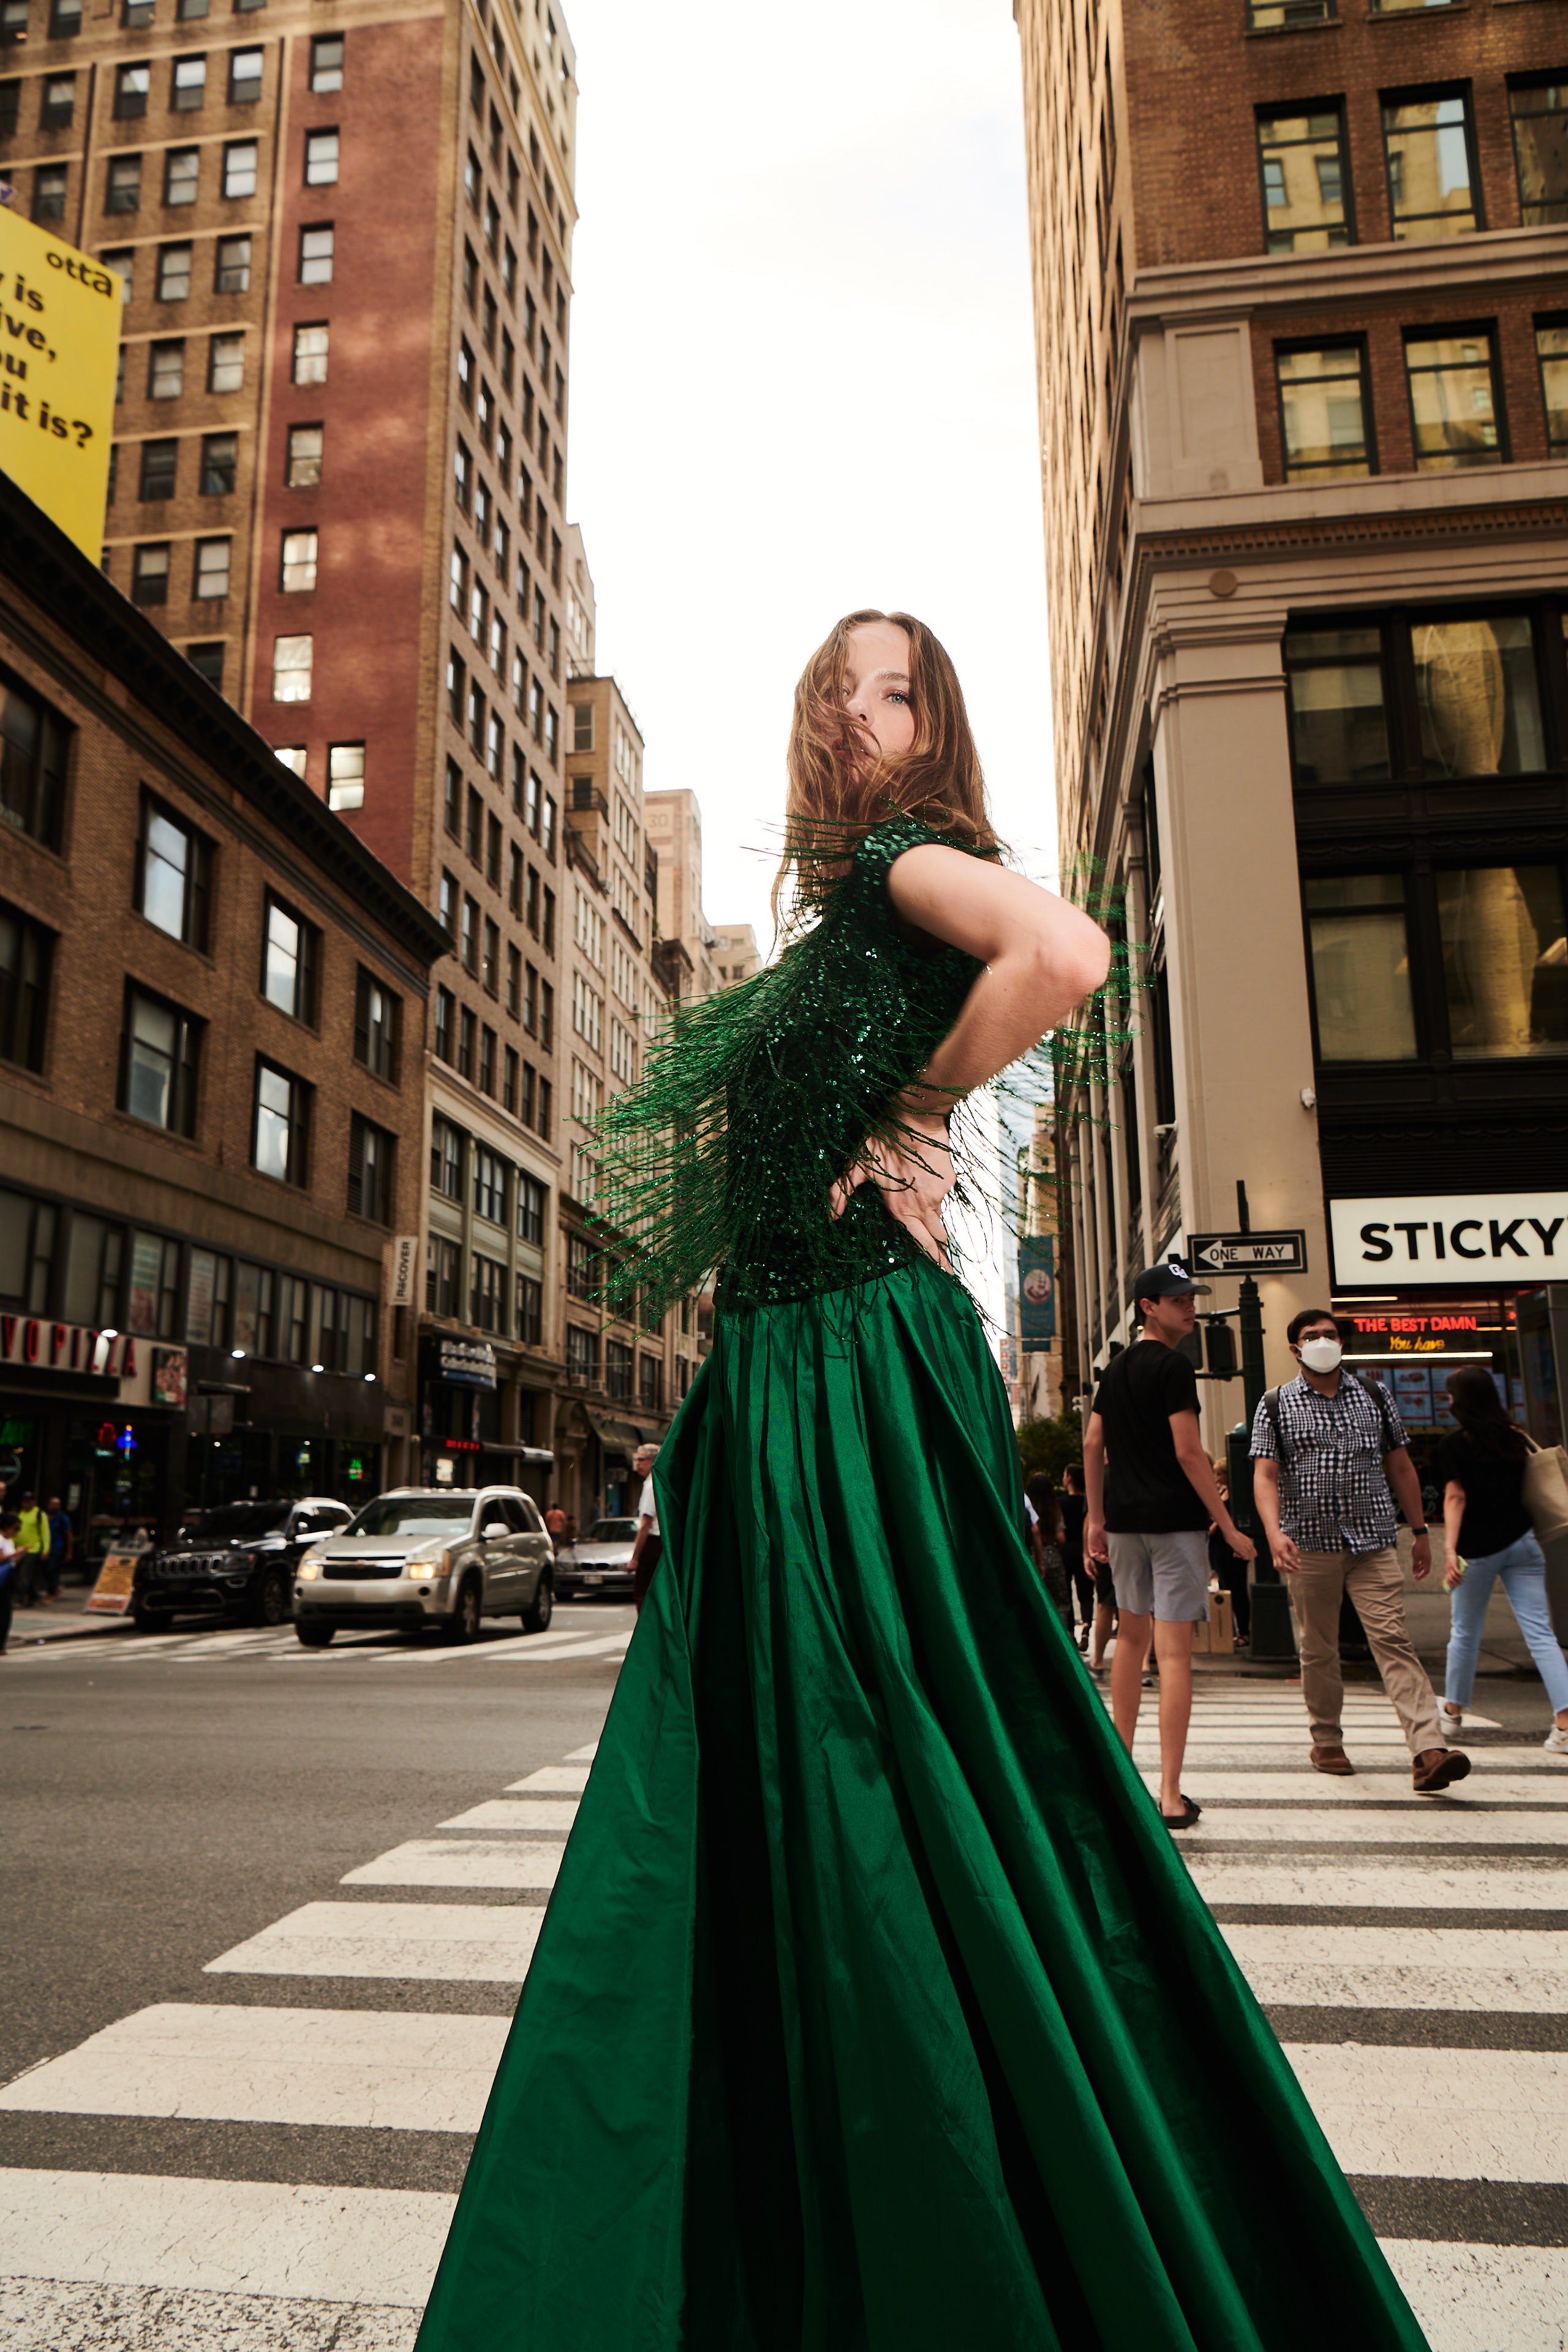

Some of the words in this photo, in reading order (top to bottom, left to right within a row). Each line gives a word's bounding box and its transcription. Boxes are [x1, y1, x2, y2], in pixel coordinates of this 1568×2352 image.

[15, 275, 44, 312] is
[47, 252, 112, 298] otta
[0, 303, 57, 362] ve,
[0, 350, 27, 382] u
[1, 382, 29, 421] it
[39, 401, 94, 448] is?
[1210, 1247, 1238, 1262] ONE
[1253, 1246, 1286, 1259] WAY
[1360, 1217, 1568, 1262] STICKY
[1354, 1317, 1388, 1332] THE
[1390, 1317, 1428, 1332] BEST
[1431, 1316, 1477, 1331] DAMN
[1390, 1335, 1412, 1351] You
[1414, 1335, 1446, 1351] have
